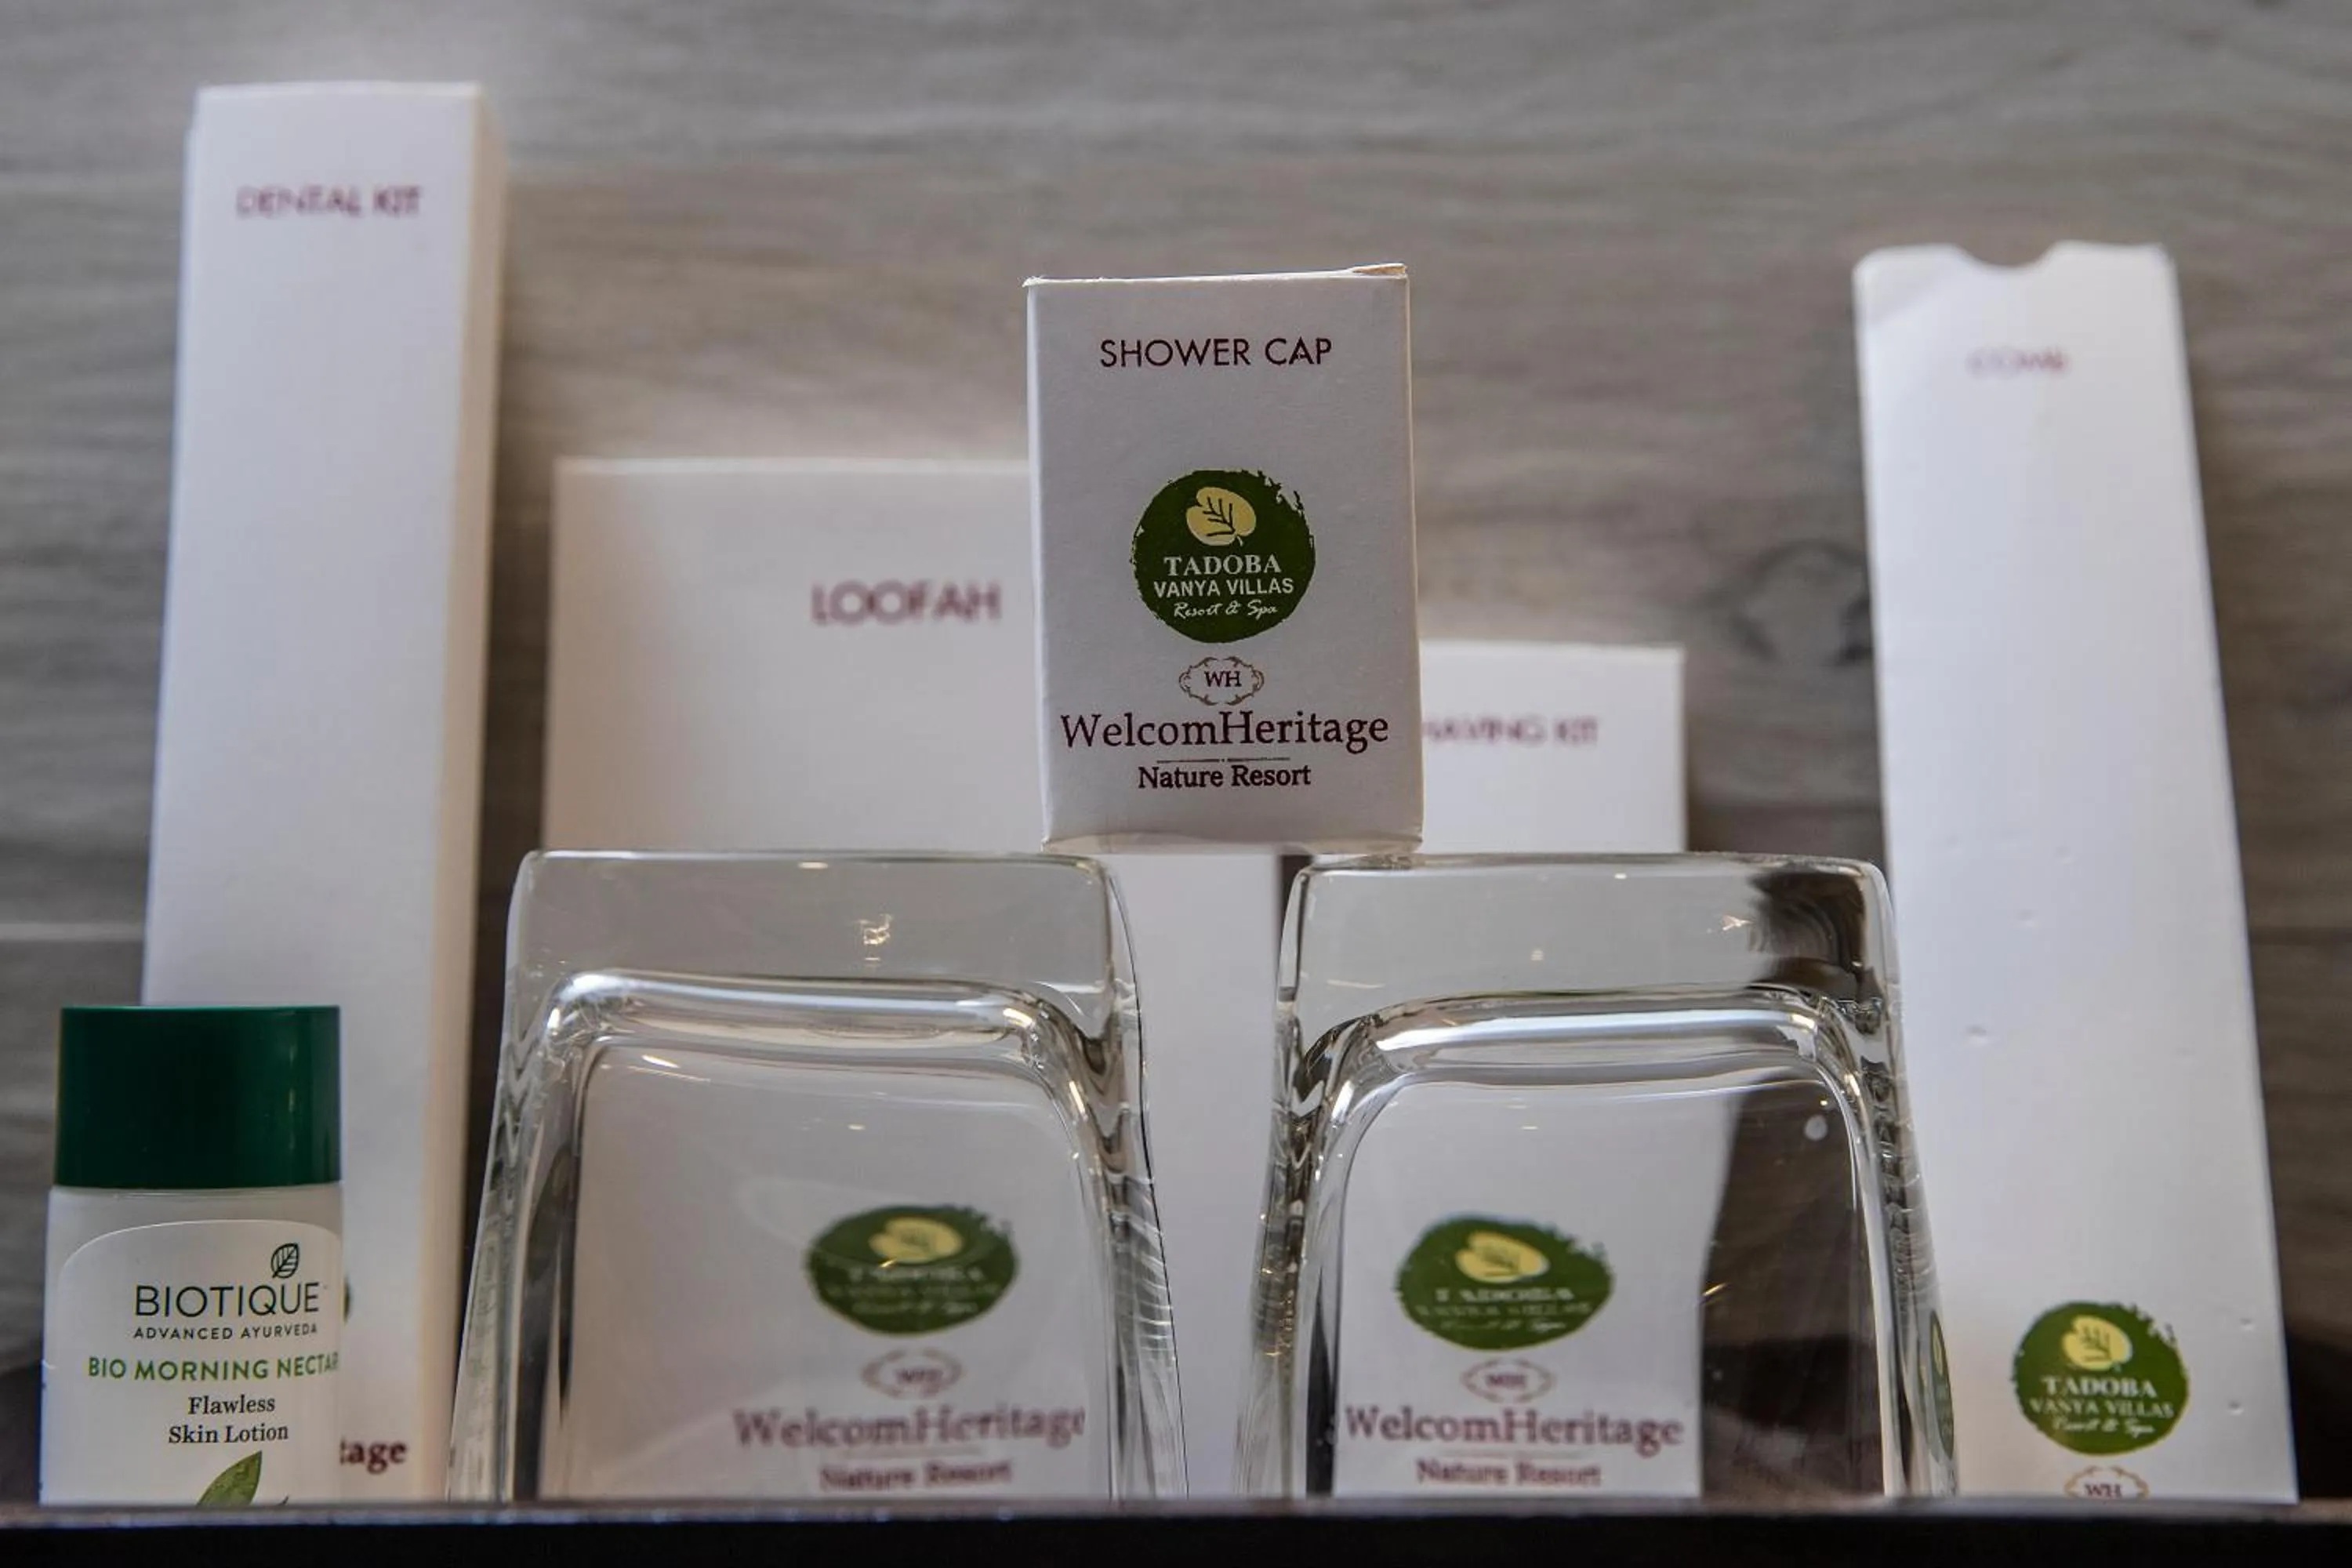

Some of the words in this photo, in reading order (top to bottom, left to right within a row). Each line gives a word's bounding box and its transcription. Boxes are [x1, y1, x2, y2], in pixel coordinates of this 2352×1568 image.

[235, 185, 363, 219] DENTAL
[371, 185, 423, 218] KIT
[1100, 338, 1250, 368] SHOWER
[1265, 337, 1333, 365] CAP
[1163, 554, 1281, 576] TADOBA
[1153, 579, 1221, 598] VANYA
[1226, 577, 1294, 595] VILLAS
[810, 579, 1002, 626] LOOFAH
[1174, 601, 1223, 619] Resort
[1225, 600, 1241, 615] &
[1247, 599, 1278, 620] Spa
[1203, 670, 1242, 688] WH
[1061, 710, 1389, 755] WelcomHeritage
[1138, 766, 1224, 789] Nature
[1231, 764, 1312, 786] Resort
[135, 1282, 320, 1318] BIOTIQUE
[133, 1327, 234, 1341] ADVANCED
[240, 1323, 318, 1339] AYURVEDA
[88, 1357, 126, 1378] BIO
[134, 1358, 269, 1381] MORNING
[277, 1352, 339, 1379] NECTAR
[2041, 1374, 2158, 1399] TADOBA
[187, 1396, 276, 1415] Flawless
[2029, 1398, 2100, 1415] VANYA
[2103, 1399, 2176, 1419] VILLAS
[168, 1425, 219, 1444] Skin
[224, 1424, 289, 1443] Lotion
[1345, 1406, 1684, 1458] WelcomHeritage
[1415, 1458, 1507, 1484] Nature
